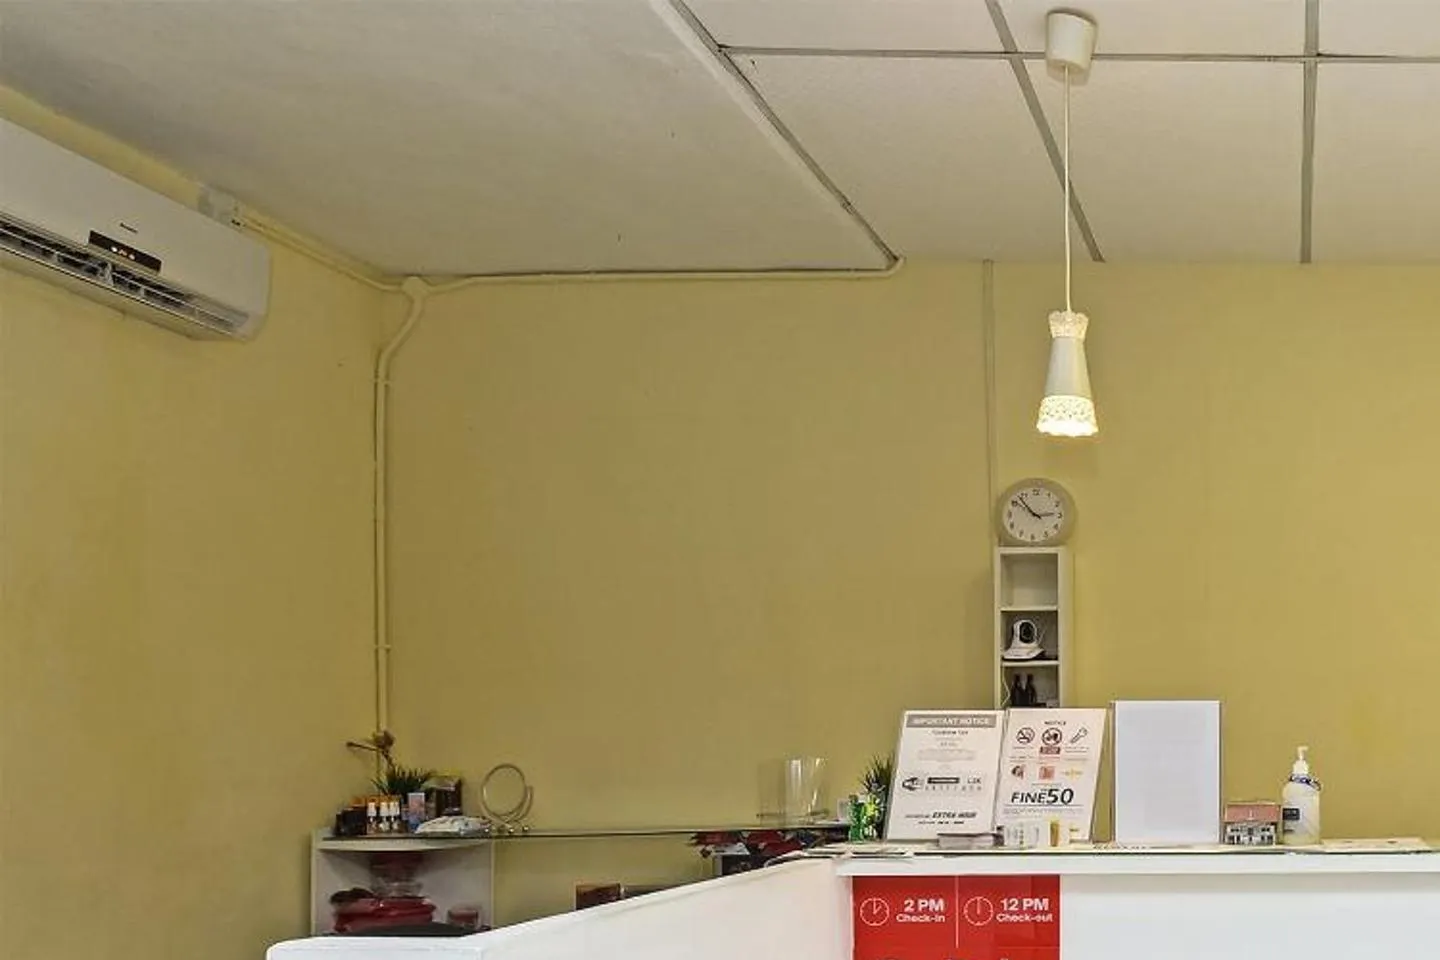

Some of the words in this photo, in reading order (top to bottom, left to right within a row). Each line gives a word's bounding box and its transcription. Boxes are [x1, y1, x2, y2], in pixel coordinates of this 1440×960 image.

[903, 898, 915, 912] 2
[918, 898, 944, 912] PM
[1001, 898, 1020, 911] 12
[1022, 898, 1049, 911] PM
[896, 913, 946, 923] Check-in
[996, 913, 1053, 923] Check-out
